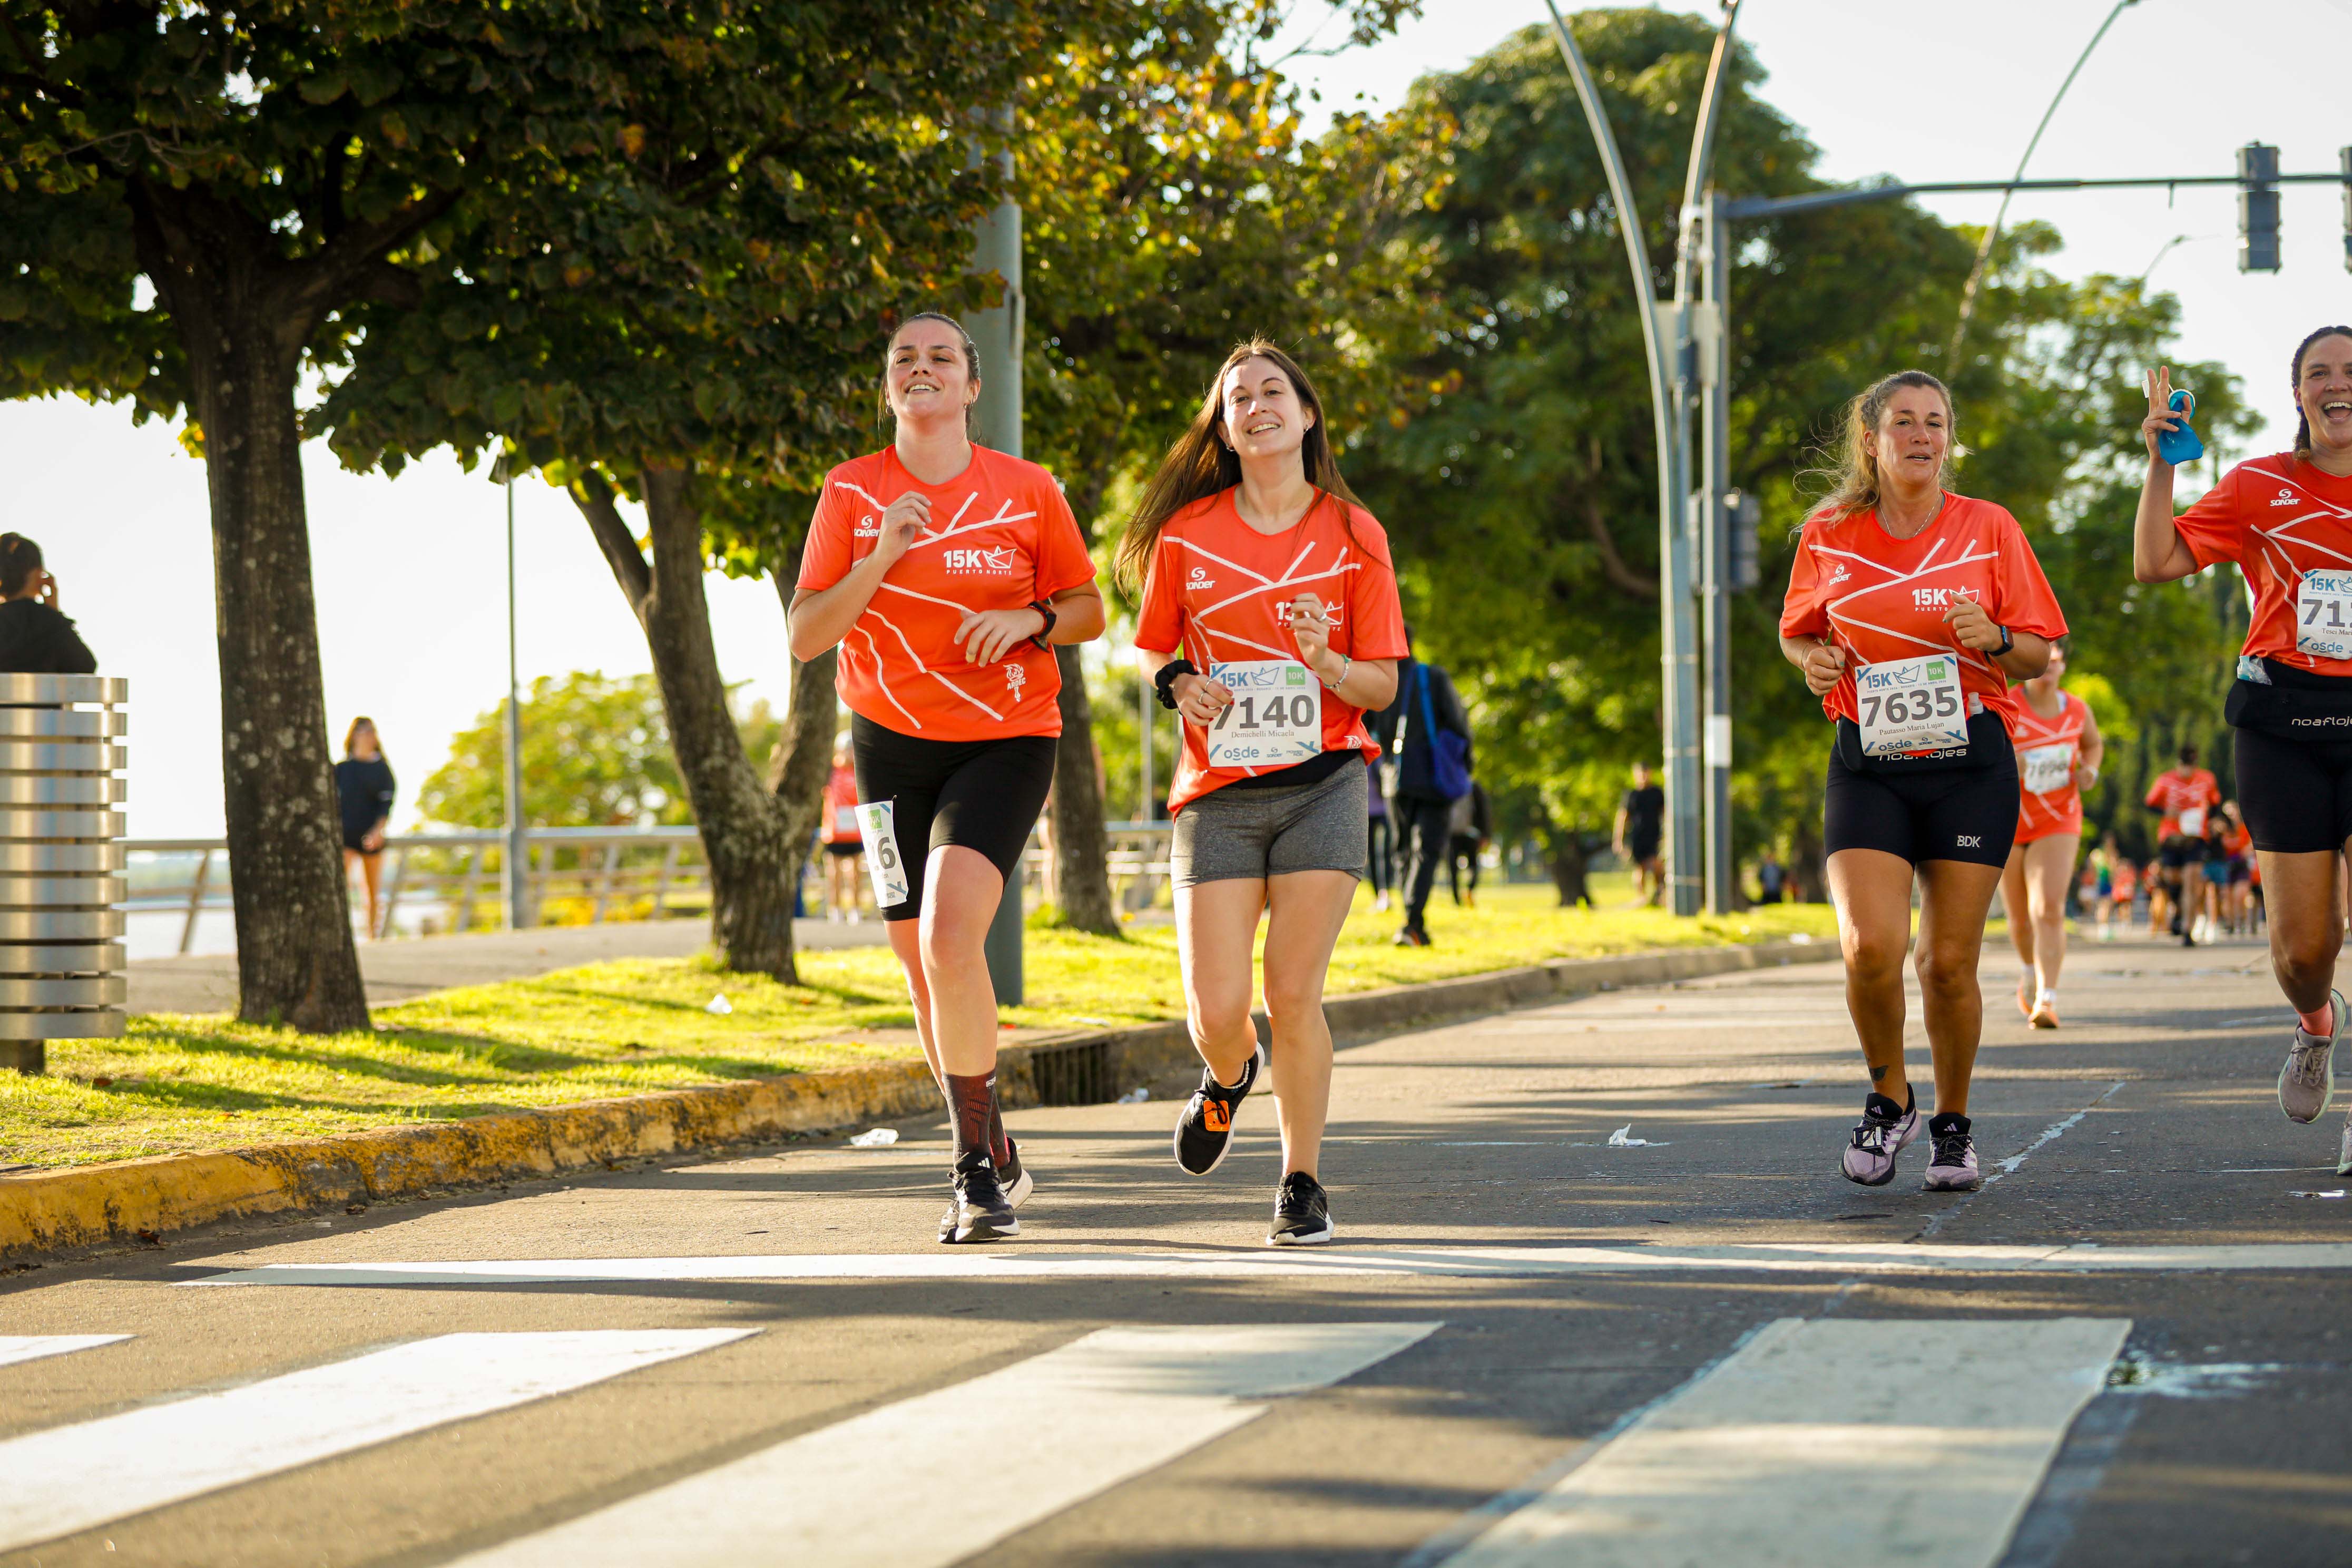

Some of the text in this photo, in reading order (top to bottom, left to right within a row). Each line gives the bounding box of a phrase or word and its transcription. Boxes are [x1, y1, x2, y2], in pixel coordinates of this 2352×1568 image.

[943, 550, 982, 568] 15K
[2310, 578, 2336, 591] 15K
[1912, 589, 1948, 605] 15K
[2302, 599, 2352, 628] 71
[2311, 641, 2344, 653] osde
[1929, 667, 1943, 675] 10K
[1007, 677, 1026, 690] ARDEC
[1221, 672, 1248, 687] 15K
[1866, 672, 1892, 688] 15K
[1214, 695, 1315, 730] 7140
[1861, 685, 1958, 728] 7635
[2291, 716, 2352, 727] noafloj
[1878, 739, 1912, 751] osde
[1224, 746, 1260, 760] osde
[1879, 749, 1966, 761] noaojes
[1957, 835, 1981, 848] BDK
